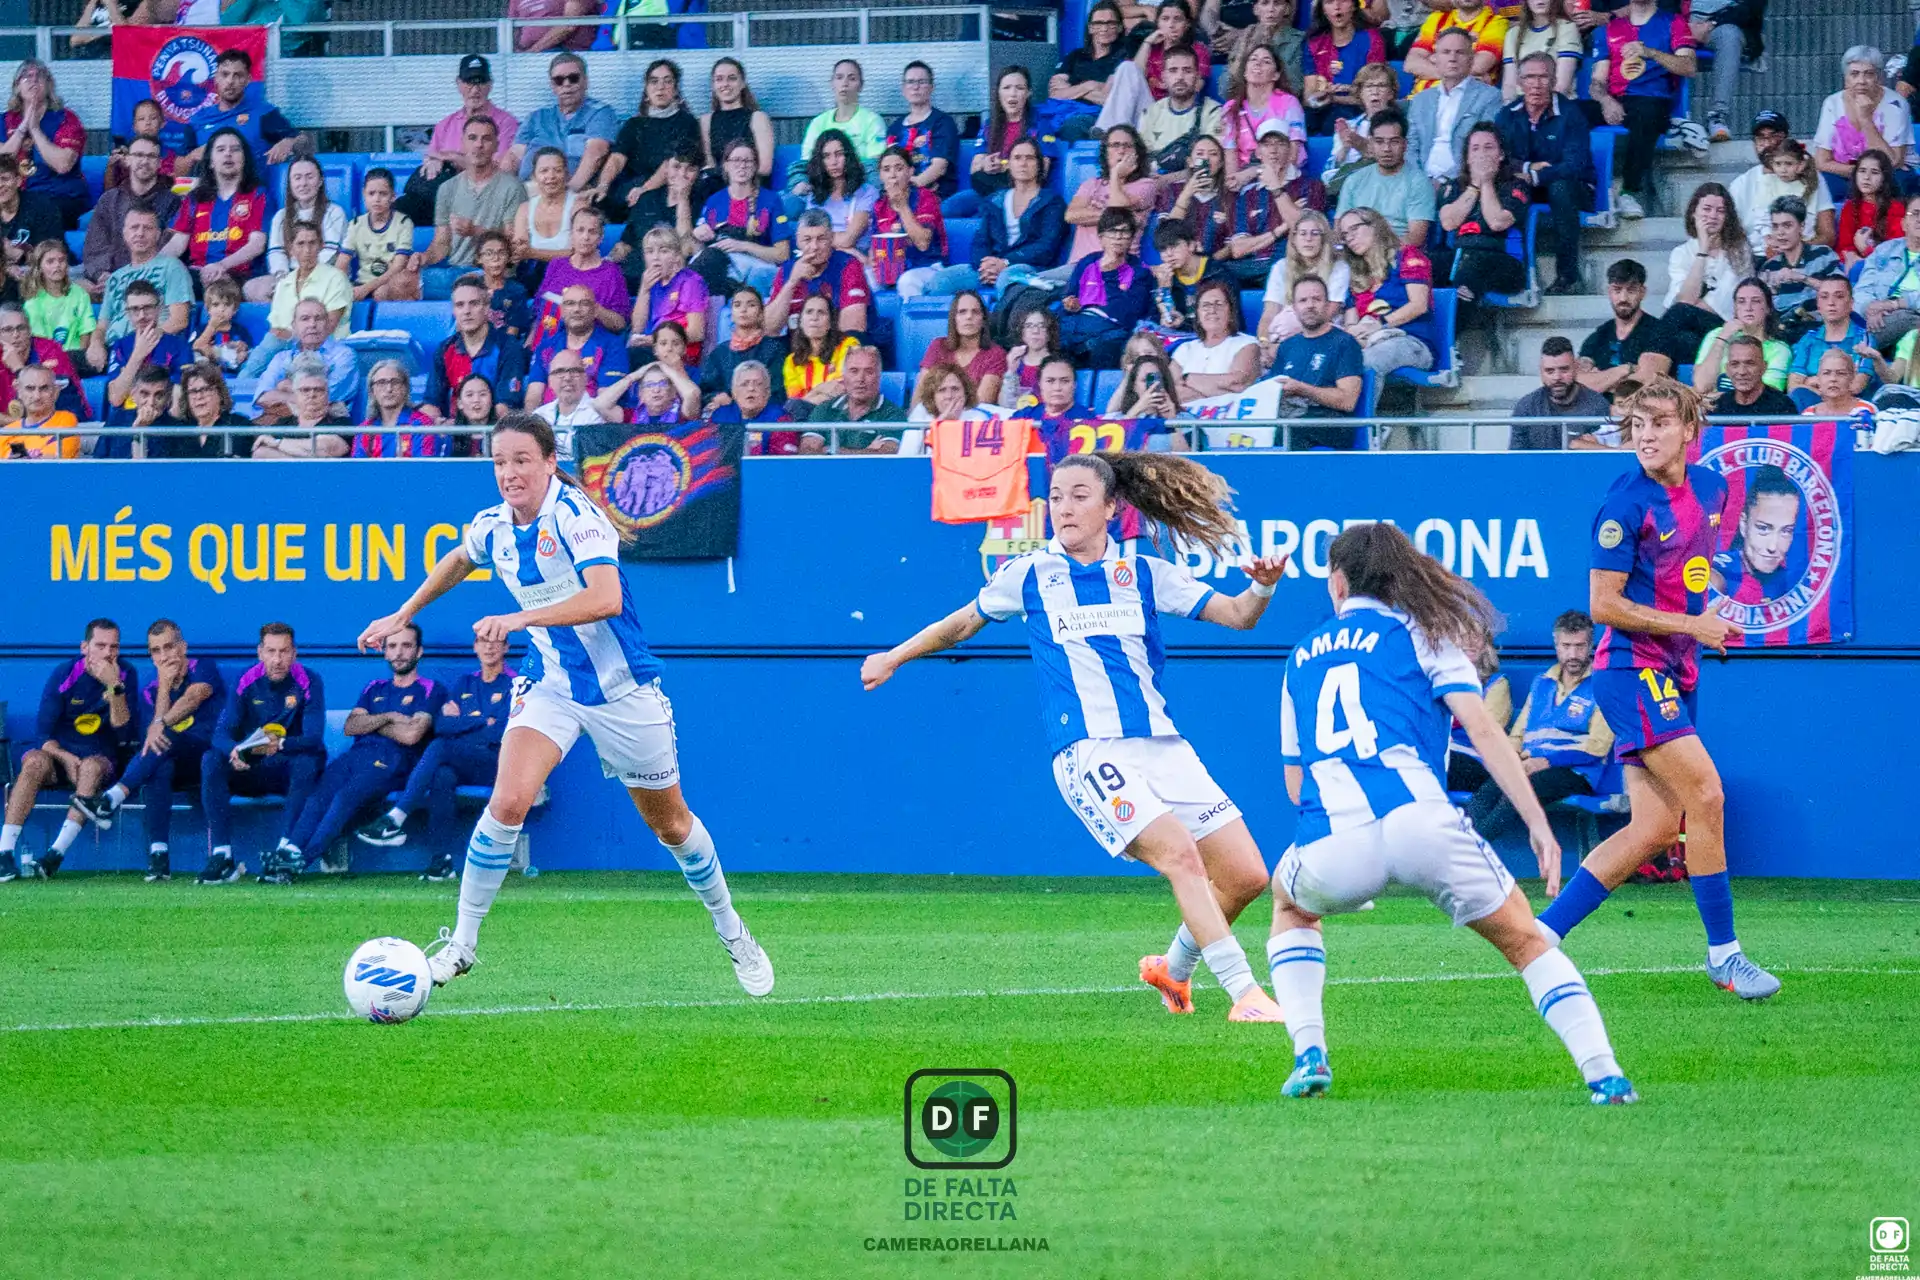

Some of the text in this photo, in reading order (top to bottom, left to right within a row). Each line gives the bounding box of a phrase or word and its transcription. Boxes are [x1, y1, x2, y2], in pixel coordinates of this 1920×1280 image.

[152, 41, 181, 77] PENYA
[961, 420, 1005, 458] 14
[1734, 447, 1834, 568] CLUB BARCELONA
[51, 505, 173, 582] MÉS
[188, 523, 307, 594] QUE
[324, 523, 406, 582] UN
[1007, 541, 1040, 552] FCB
[1174, 518, 1549, 579] BARCONA
[1770, 583, 1817, 620] PINA
[1070, 620, 1109, 632] GLOBAL
[1295, 628, 1379, 668] AMAIA
[1639, 667, 1679, 702] 12
[1316, 662, 1379, 760] 4
[626, 767, 675, 781] SKODA
[1084, 762, 1126, 802] 19
[1198, 799, 1233, 824] SKOD
